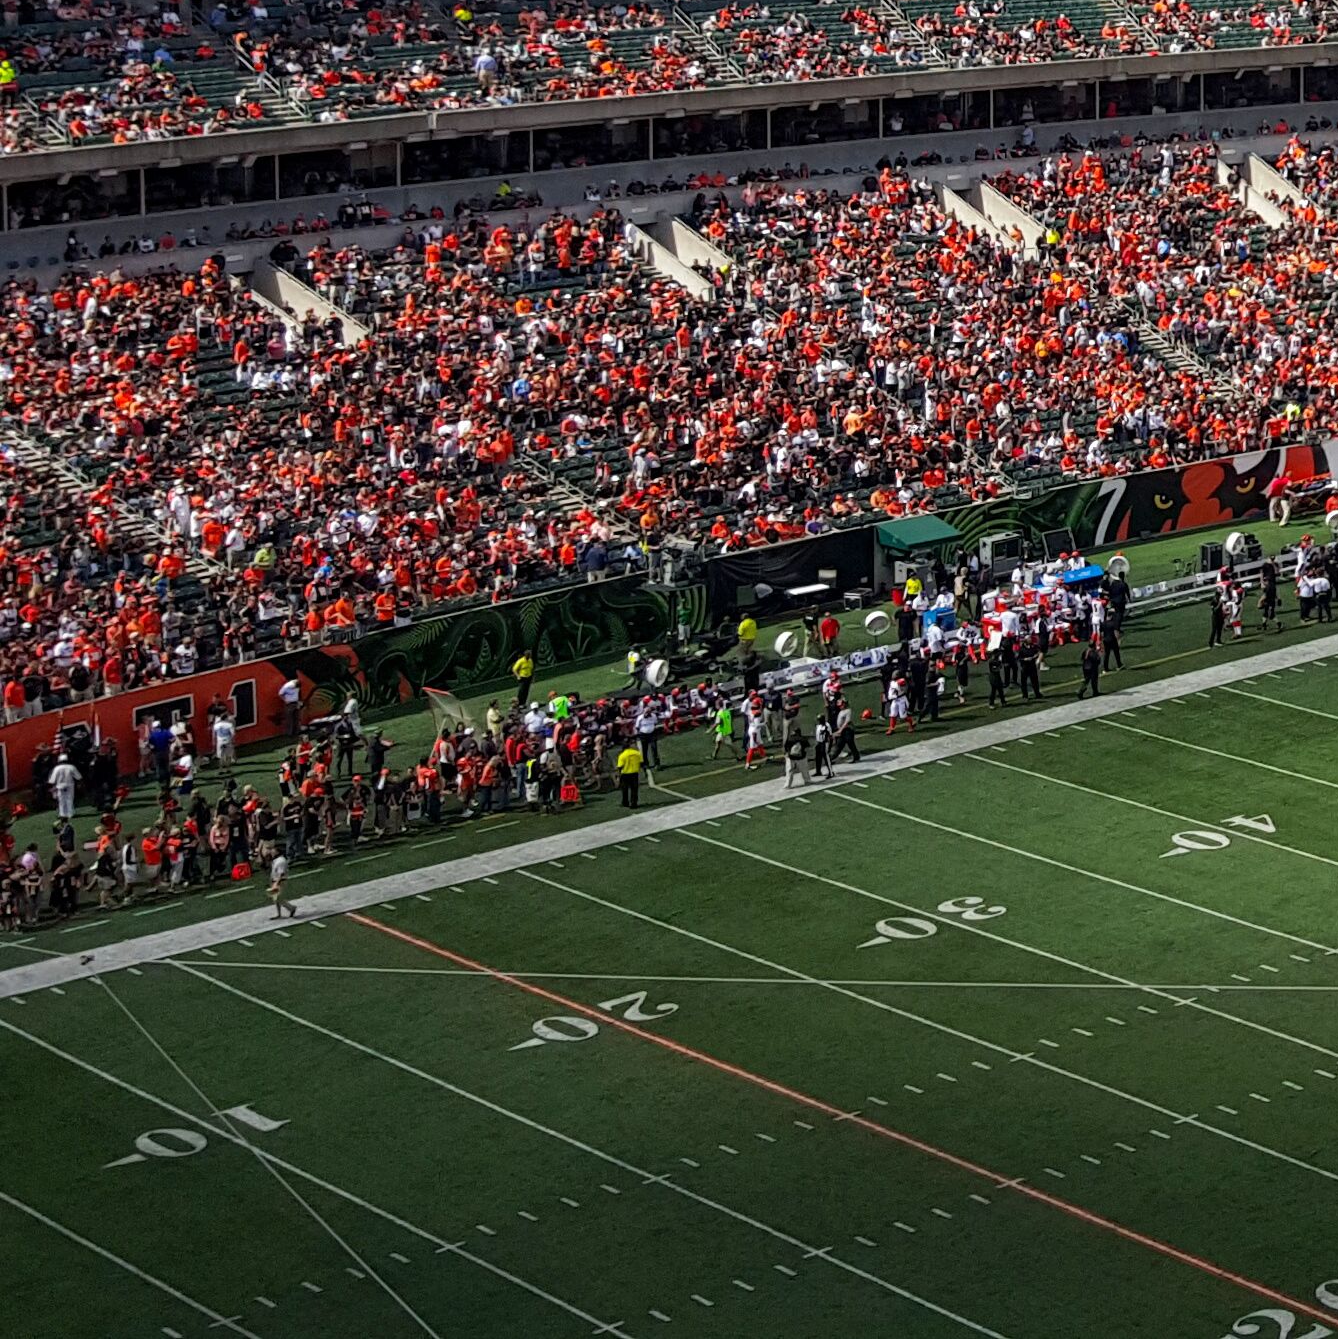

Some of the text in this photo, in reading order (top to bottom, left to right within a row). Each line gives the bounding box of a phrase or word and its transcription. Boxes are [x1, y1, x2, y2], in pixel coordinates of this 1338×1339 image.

[1170, 813, 1278, 851] 40
[874, 895, 1007, 940] 30
[530, 990, 680, 1042] 20
[134, 1103, 292, 1159] 10
